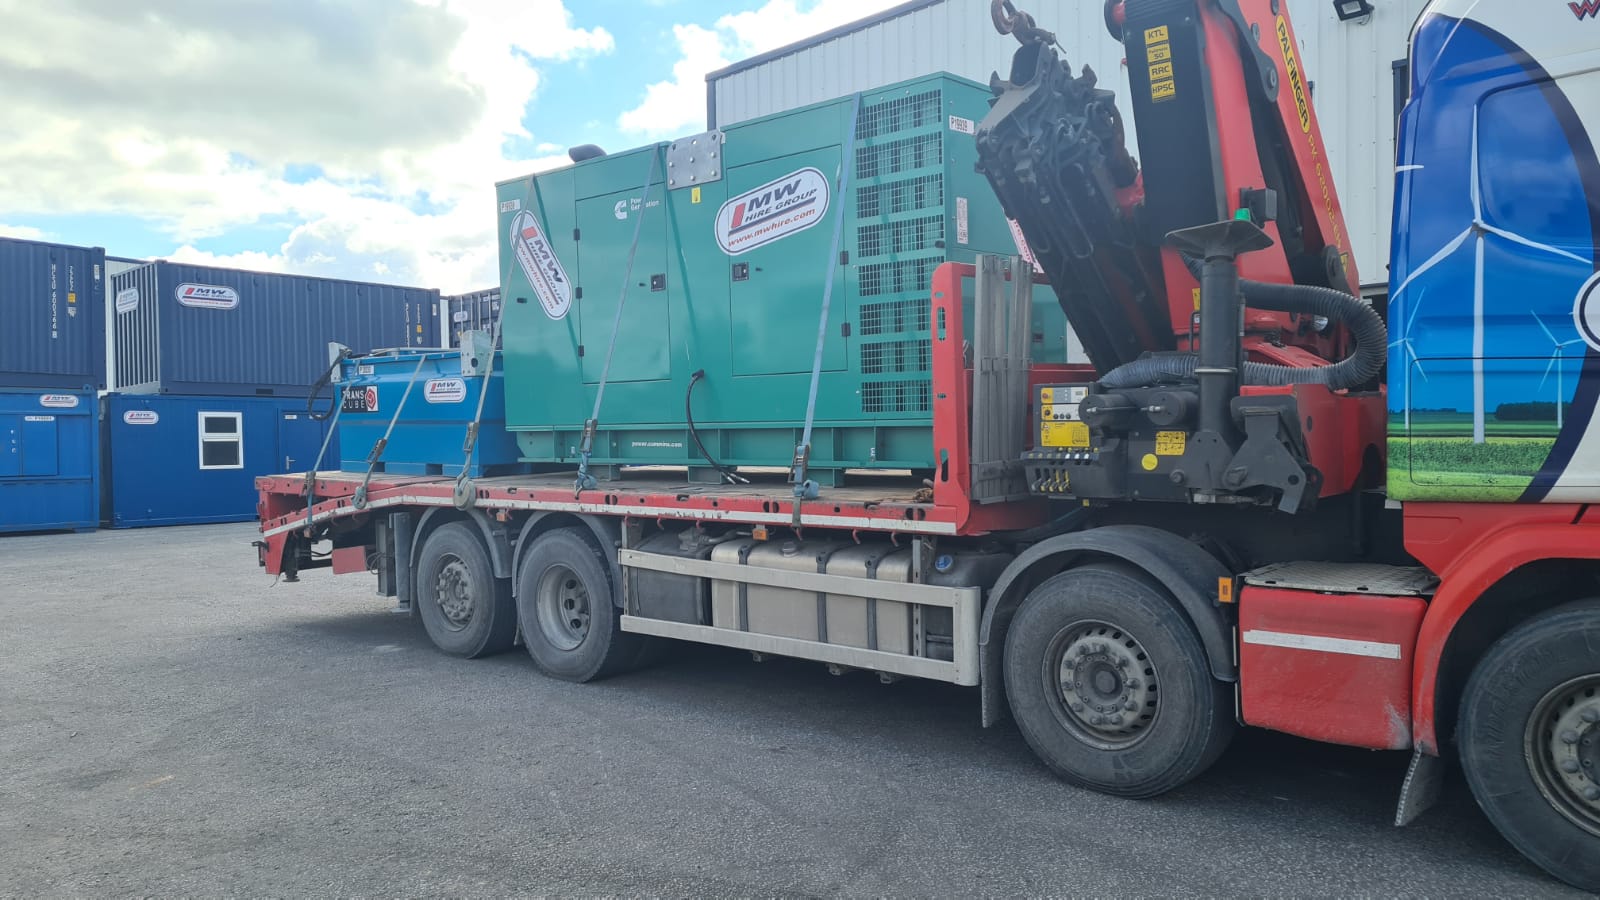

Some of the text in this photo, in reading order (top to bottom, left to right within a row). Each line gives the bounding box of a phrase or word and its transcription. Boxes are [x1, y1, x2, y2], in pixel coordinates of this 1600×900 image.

[1148, 29, 1165, 40] KTL
[1151, 65, 1170, 76] RRC
[1277, 22, 1308, 128] PALFINGER
[1152, 82, 1174, 94] HPSC
[745, 188, 818, 223] HIRE GROUP
[748, 178, 802, 212] MW
[728, 208, 816, 247] www.mwhire.com
[529, 242, 564, 303] HIRE GROUP
[534, 239, 563, 283] MW
[342, 389, 365, 401] TRANS
[436, 381, 456, 390] MW
[342, 400, 365, 409] CUBE
